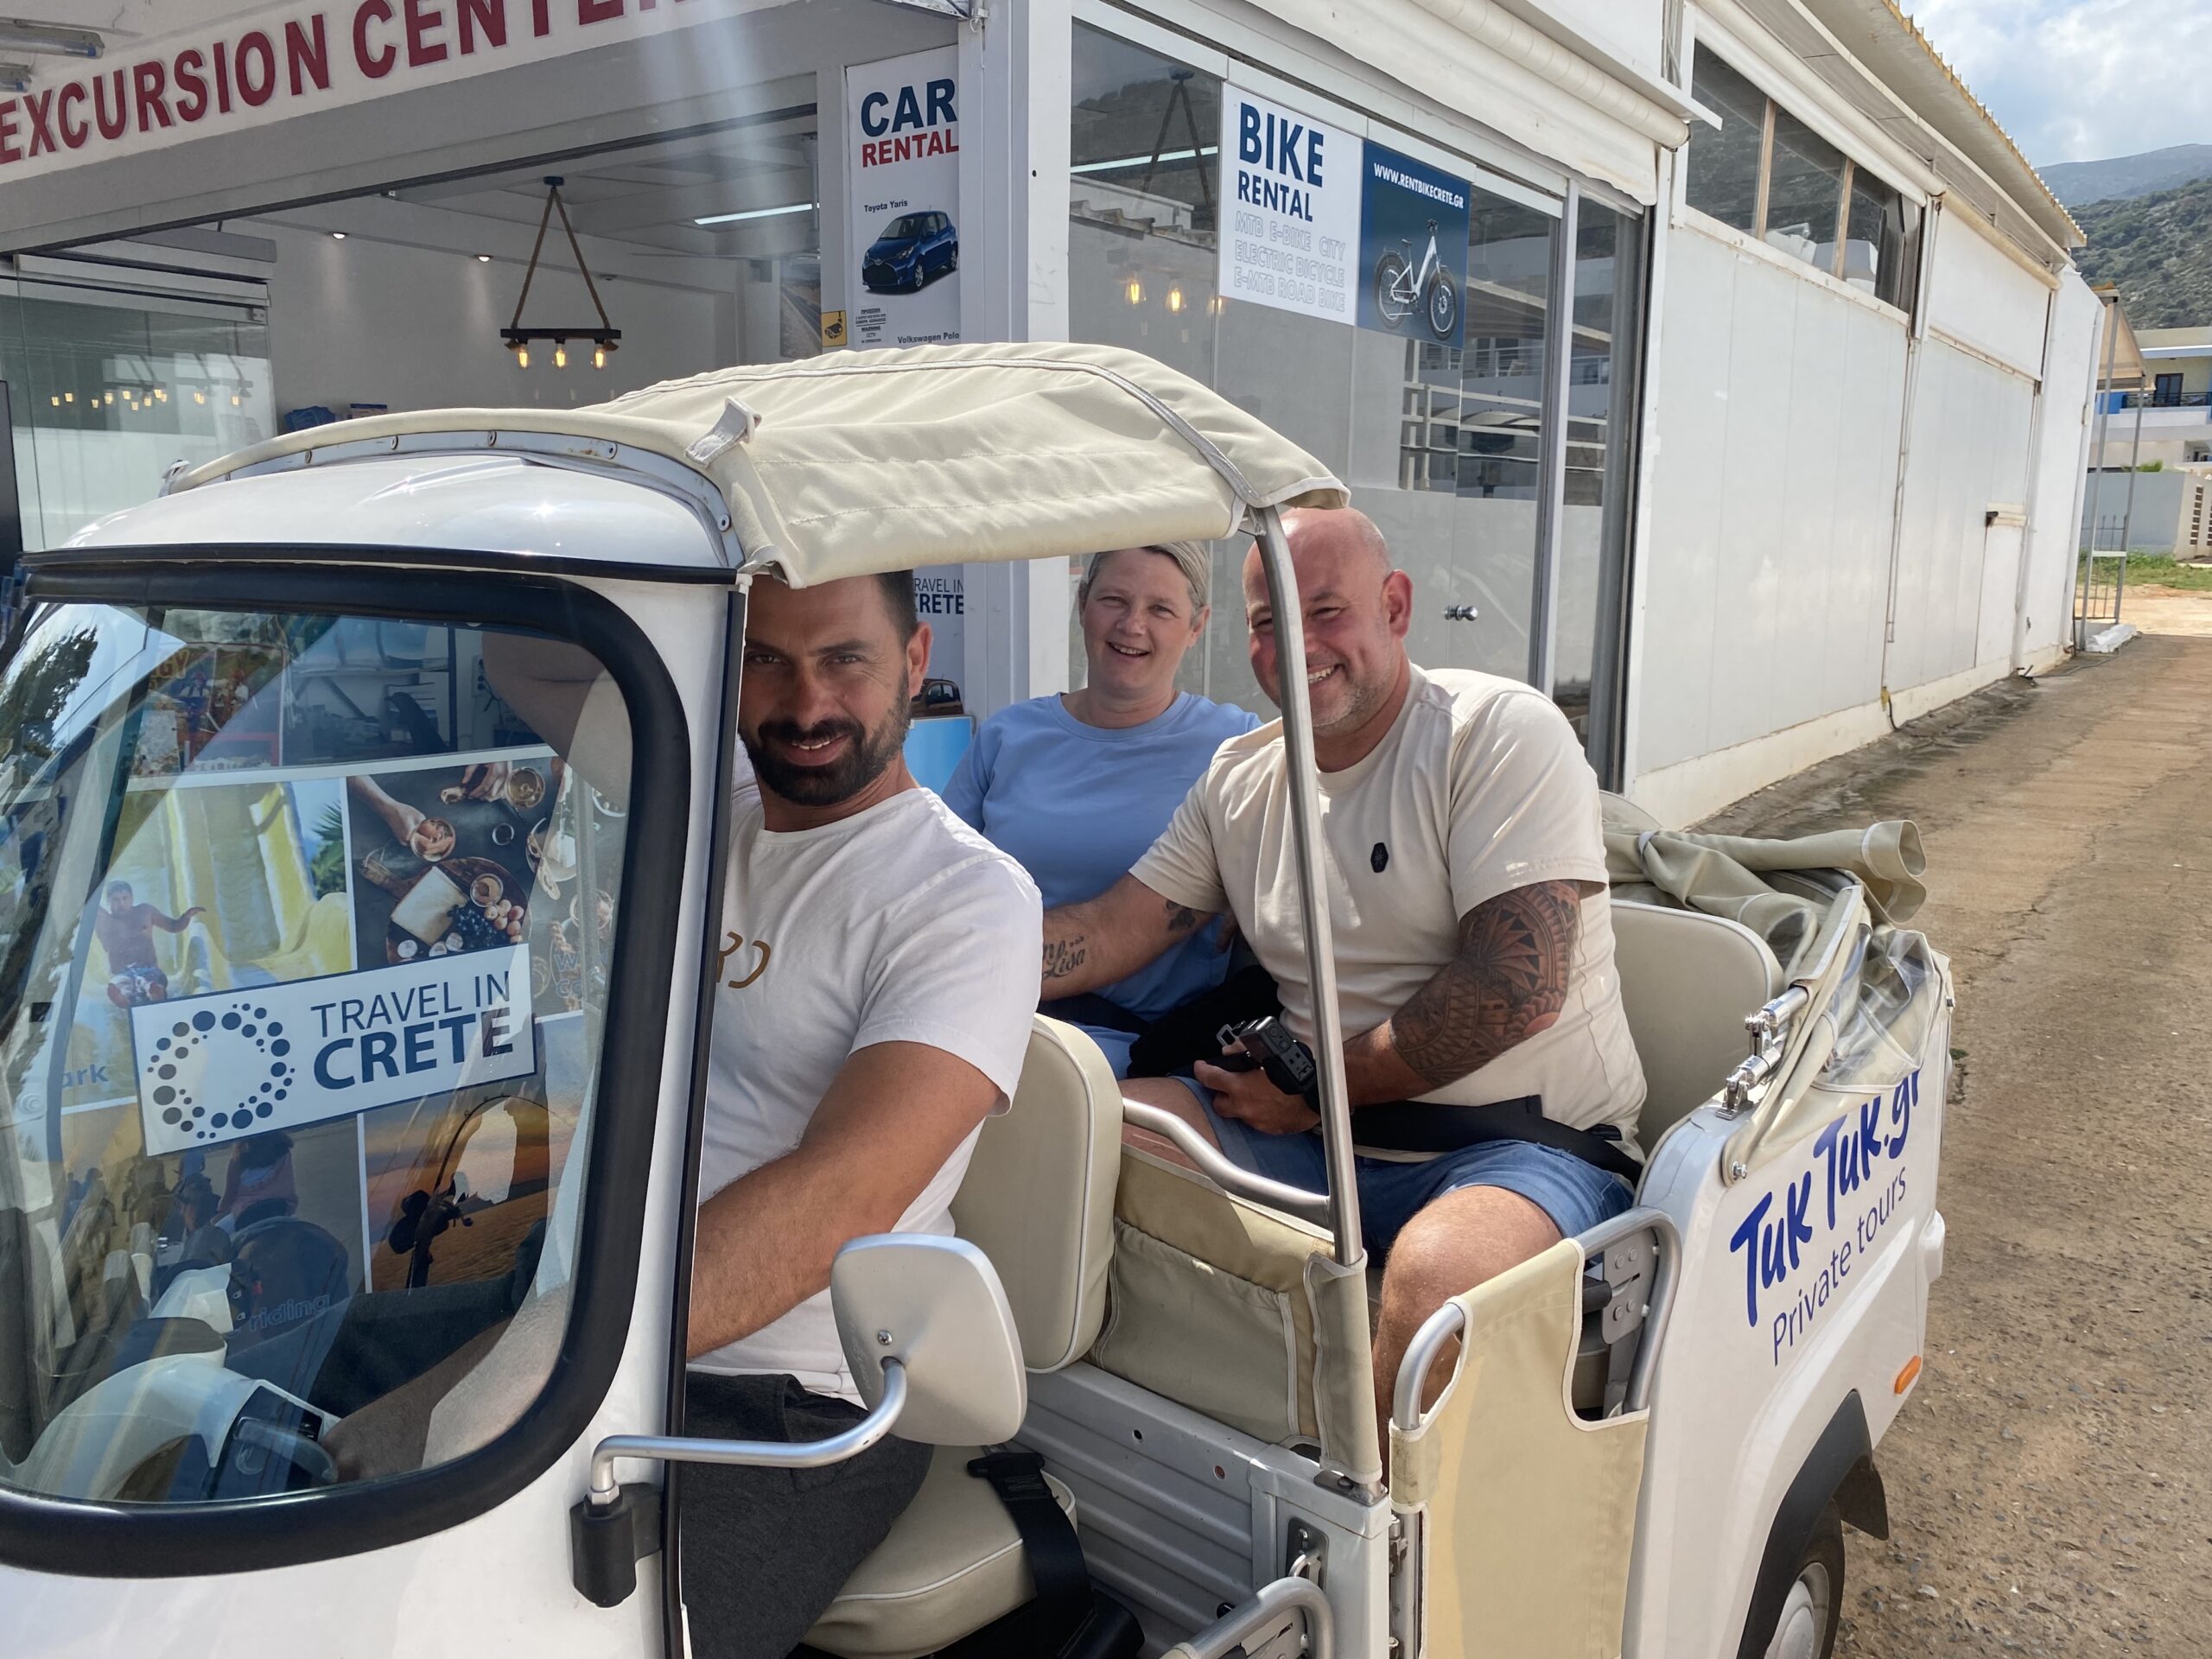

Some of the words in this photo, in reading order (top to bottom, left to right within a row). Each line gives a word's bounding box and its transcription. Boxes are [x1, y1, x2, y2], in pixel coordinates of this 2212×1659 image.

[0, 15, 332, 164] EXCURSION
[861, 78, 958, 138] CAR
[862, 128, 960, 168] RENTAL
[1239, 102, 1325, 188] BIKE
[864, 203, 888, 213] Toyota
[890, 199, 908, 209] Yaris
[1237, 169, 1313, 223] RENTAL
[1373, 162, 1464, 209] WWW.RENTBIKECRETE.GR
[1235, 210, 1264, 238] MTB
[1269, 220, 1312, 251] E-BIKE
[1319, 236, 1346, 261] CITY
[1235, 239, 1294, 275] ELECTRIC
[1295, 256, 1345, 288] BICYCLE
[1234, 266, 1274, 295] E-MTB
[1278, 276, 1315, 305] ROAD
[1318, 287, 1345, 312] BIKE
[898, 334, 942, 344] Volkswagen
[943, 331, 960, 340] Polo
[913, 577, 950, 593] RAVEL
[913, 593, 964, 615] RETE
[310, 982, 463, 1038] TRAVEL
[474, 970, 511, 1008] IN
[313, 1007, 514, 1090] CRETE
[62, 1064, 111, 1089] ark
[1772, 1240, 1852, 1367] Private
[1856, 1166, 1906, 1255] tours
